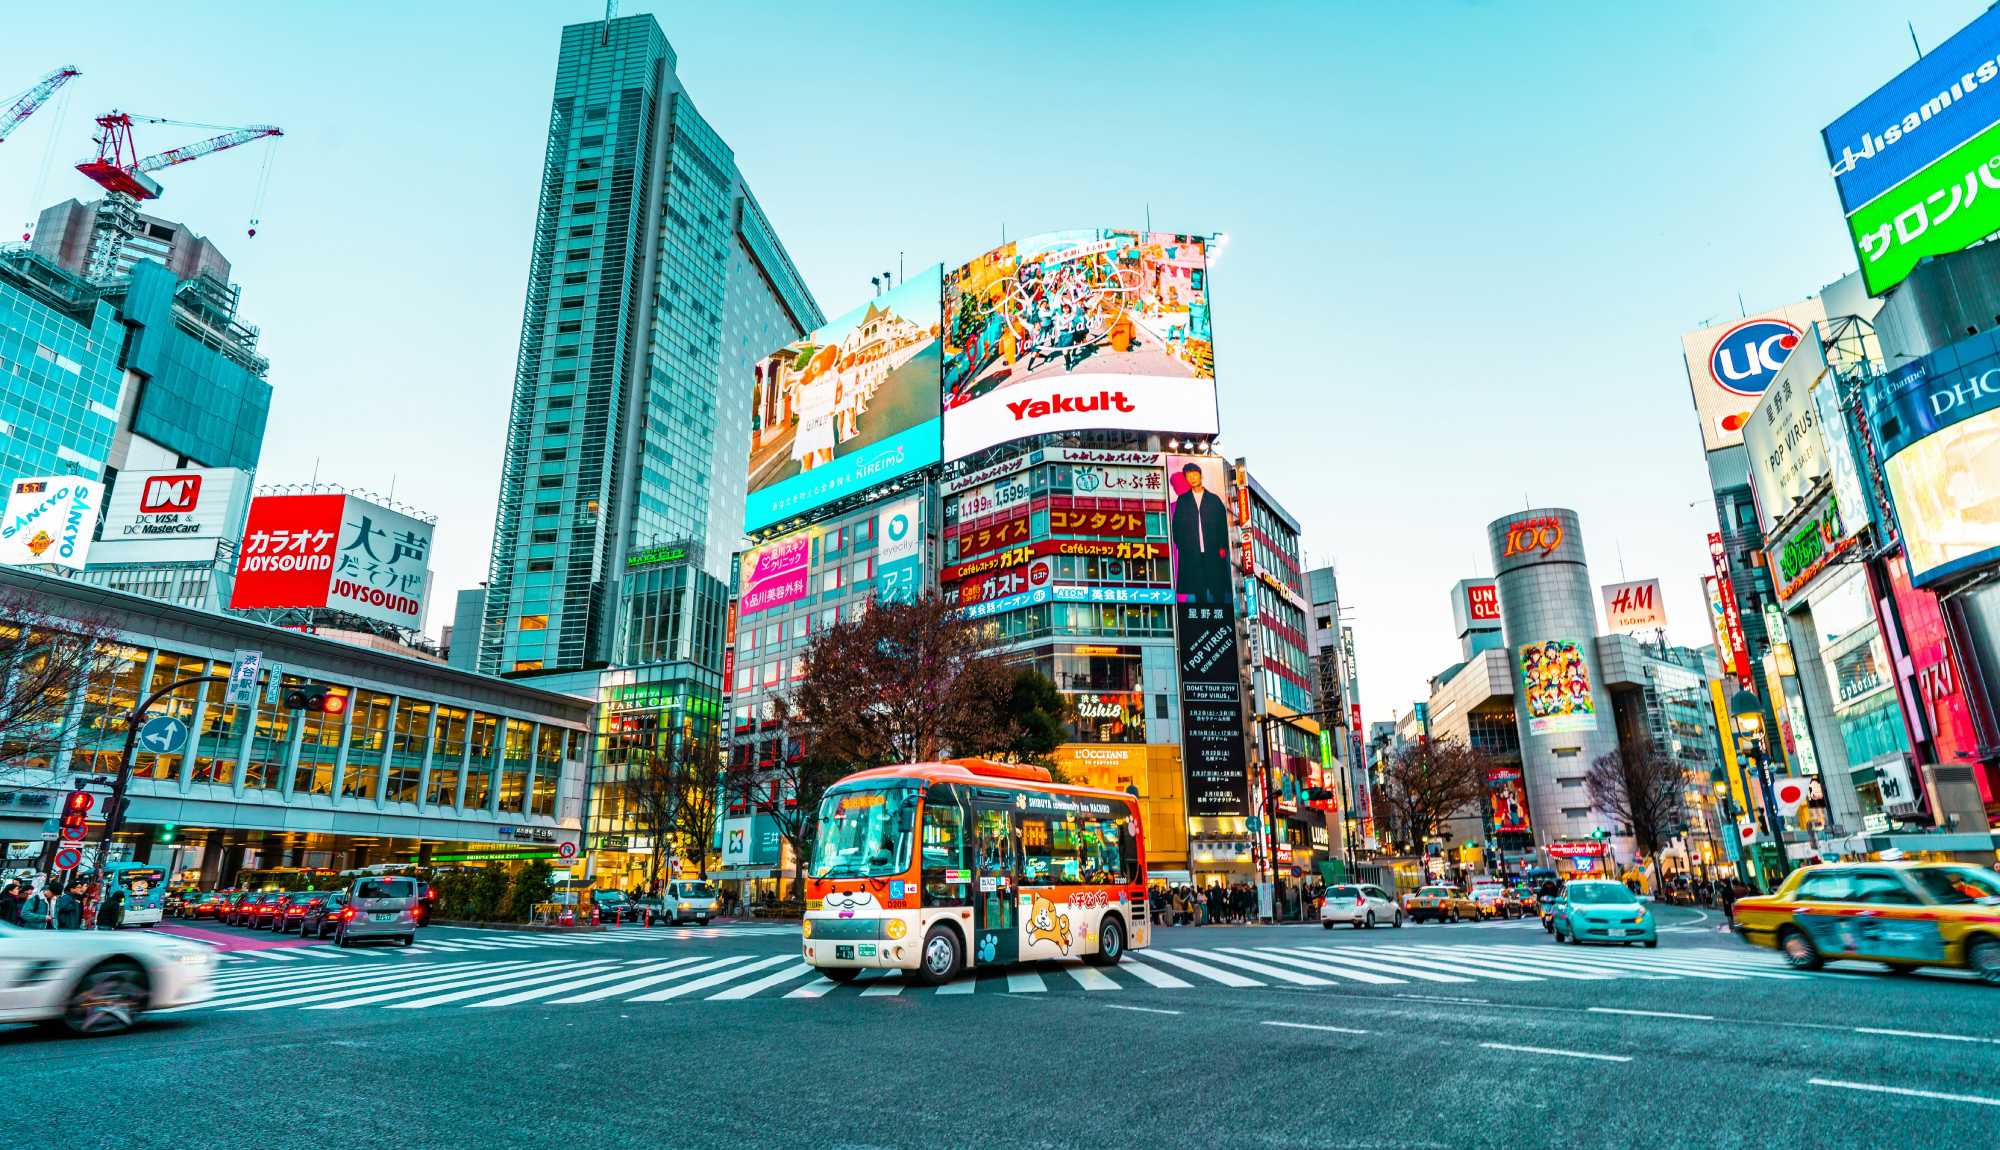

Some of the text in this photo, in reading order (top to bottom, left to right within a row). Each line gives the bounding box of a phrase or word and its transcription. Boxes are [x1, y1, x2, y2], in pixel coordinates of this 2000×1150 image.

[1830, 53, 2000, 177] Hisamits
[1886, 366, 1927, 395] Channel
[1006, 391, 1136, 421] Yakult
[856, 446, 905, 479] KIREIMO
[145, 480, 194, 507] DC
[1105, 472, 1161, 490] しゃぶ葉
[2, 487, 69, 539] SANKYO
[60, 485, 92, 558] SANKYO
[155, 514, 178, 523] VISA
[946, 505, 958, 517] 9F
[1051, 512, 1142, 530] コンタクト
[142, 524, 200, 534] MasterCard
[247, 529, 335, 554] カラオケ
[340, 515, 428, 565] 大声
[961, 519, 1028, 553] プライス
[1503, 526, 1564, 558] 109
[242, 554, 331, 572] JOYSOUND
[771, 553, 801, 571] クリニック
[1000, 546, 1035, 568] ガスト
[1117, 543, 1159, 559] ガスト
[332, 578, 419, 616] JOYSOUND
[749, 579, 804, 608] 品川美容外科
[944, 590, 959, 605] 7F
[982, 573, 1025, 600] ガスト
[1092, 589, 1173, 601] 英会話イーオン
[1612, 585, 1654, 614] H&M
[969, 595, 1031, 618] 英会話イーオン
